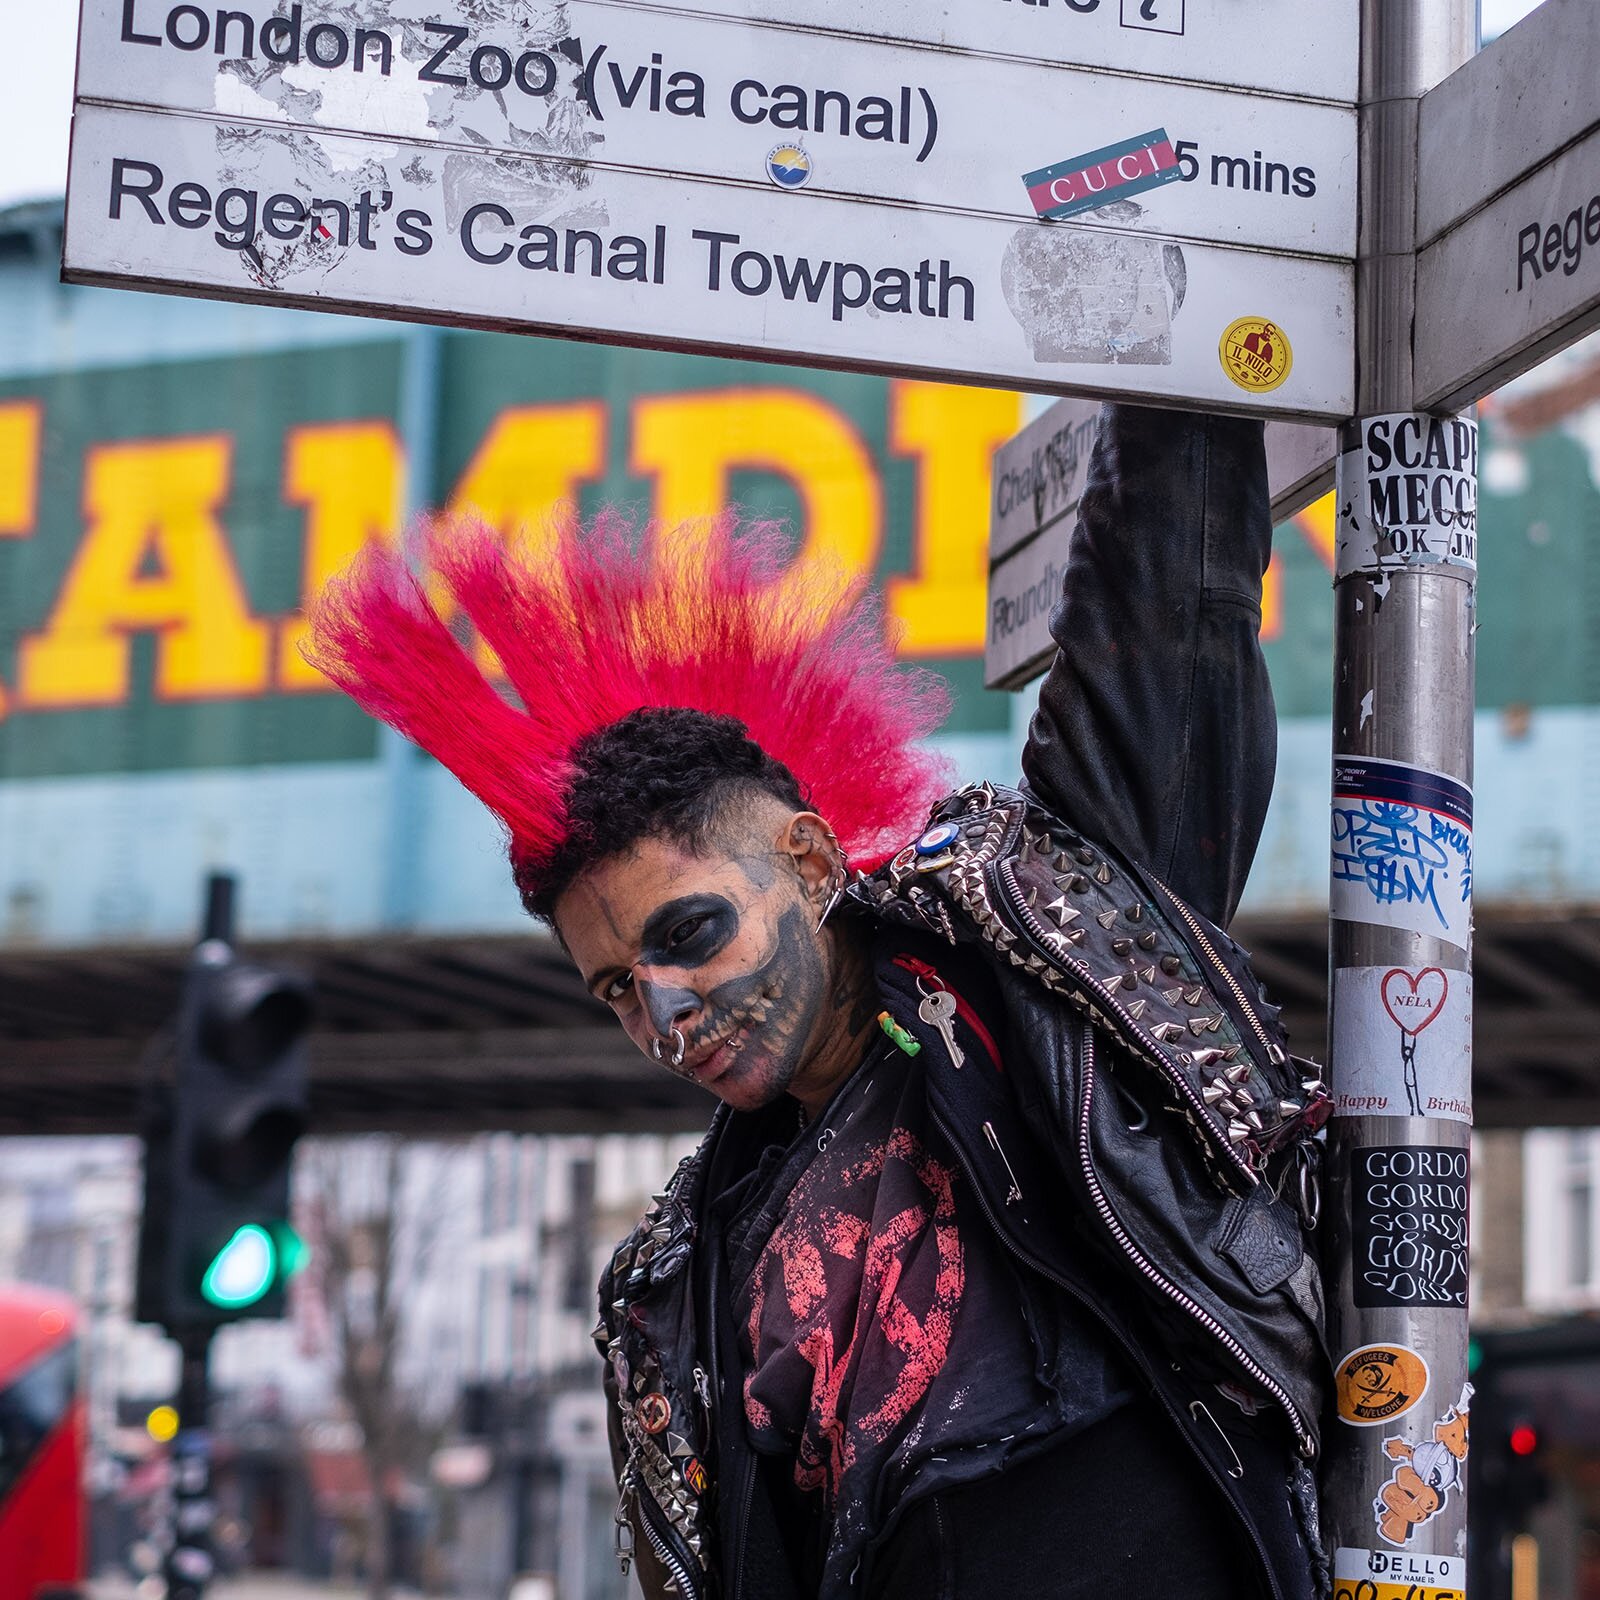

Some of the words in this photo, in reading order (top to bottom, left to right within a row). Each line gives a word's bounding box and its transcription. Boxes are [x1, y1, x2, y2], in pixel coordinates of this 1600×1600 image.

[120, 0, 393, 77] London
[417, 22, 557, 98] Zoo
[583, 45, 706, 121] (via
[729, 78, 938, 163] canal)
[1210, 150, 1317, 198] mins
[460, 203, 666, 285] Canal
[692, 229, 974, 321] Towpath
[1232, 345, 1242, 361] IL
[1244, 352, 1273, 378] NULO
[1368, 473, 1476, 531] MECC
[1393, 995, 1433, 1008] NELA
[1337, 1094, 1388, 1109] Happy
[1366, 1151, 1467, 1178] GORDO
[1367, 1183, 1467, 1212] GORDO
[1370, 1213, 1468, 1247] GORDO
[1350, 1352, 1390, 1372] REFUGEES
[1360, 1398, 1402, 1418] WELCOME
[1368, 1552, 1450, 1577] HELLO
[1389, 1573, 1402, 1581] MY
[1403, 1574, 1426, 1584] NAME
[1427, 1576, 1435, 1584] IS
